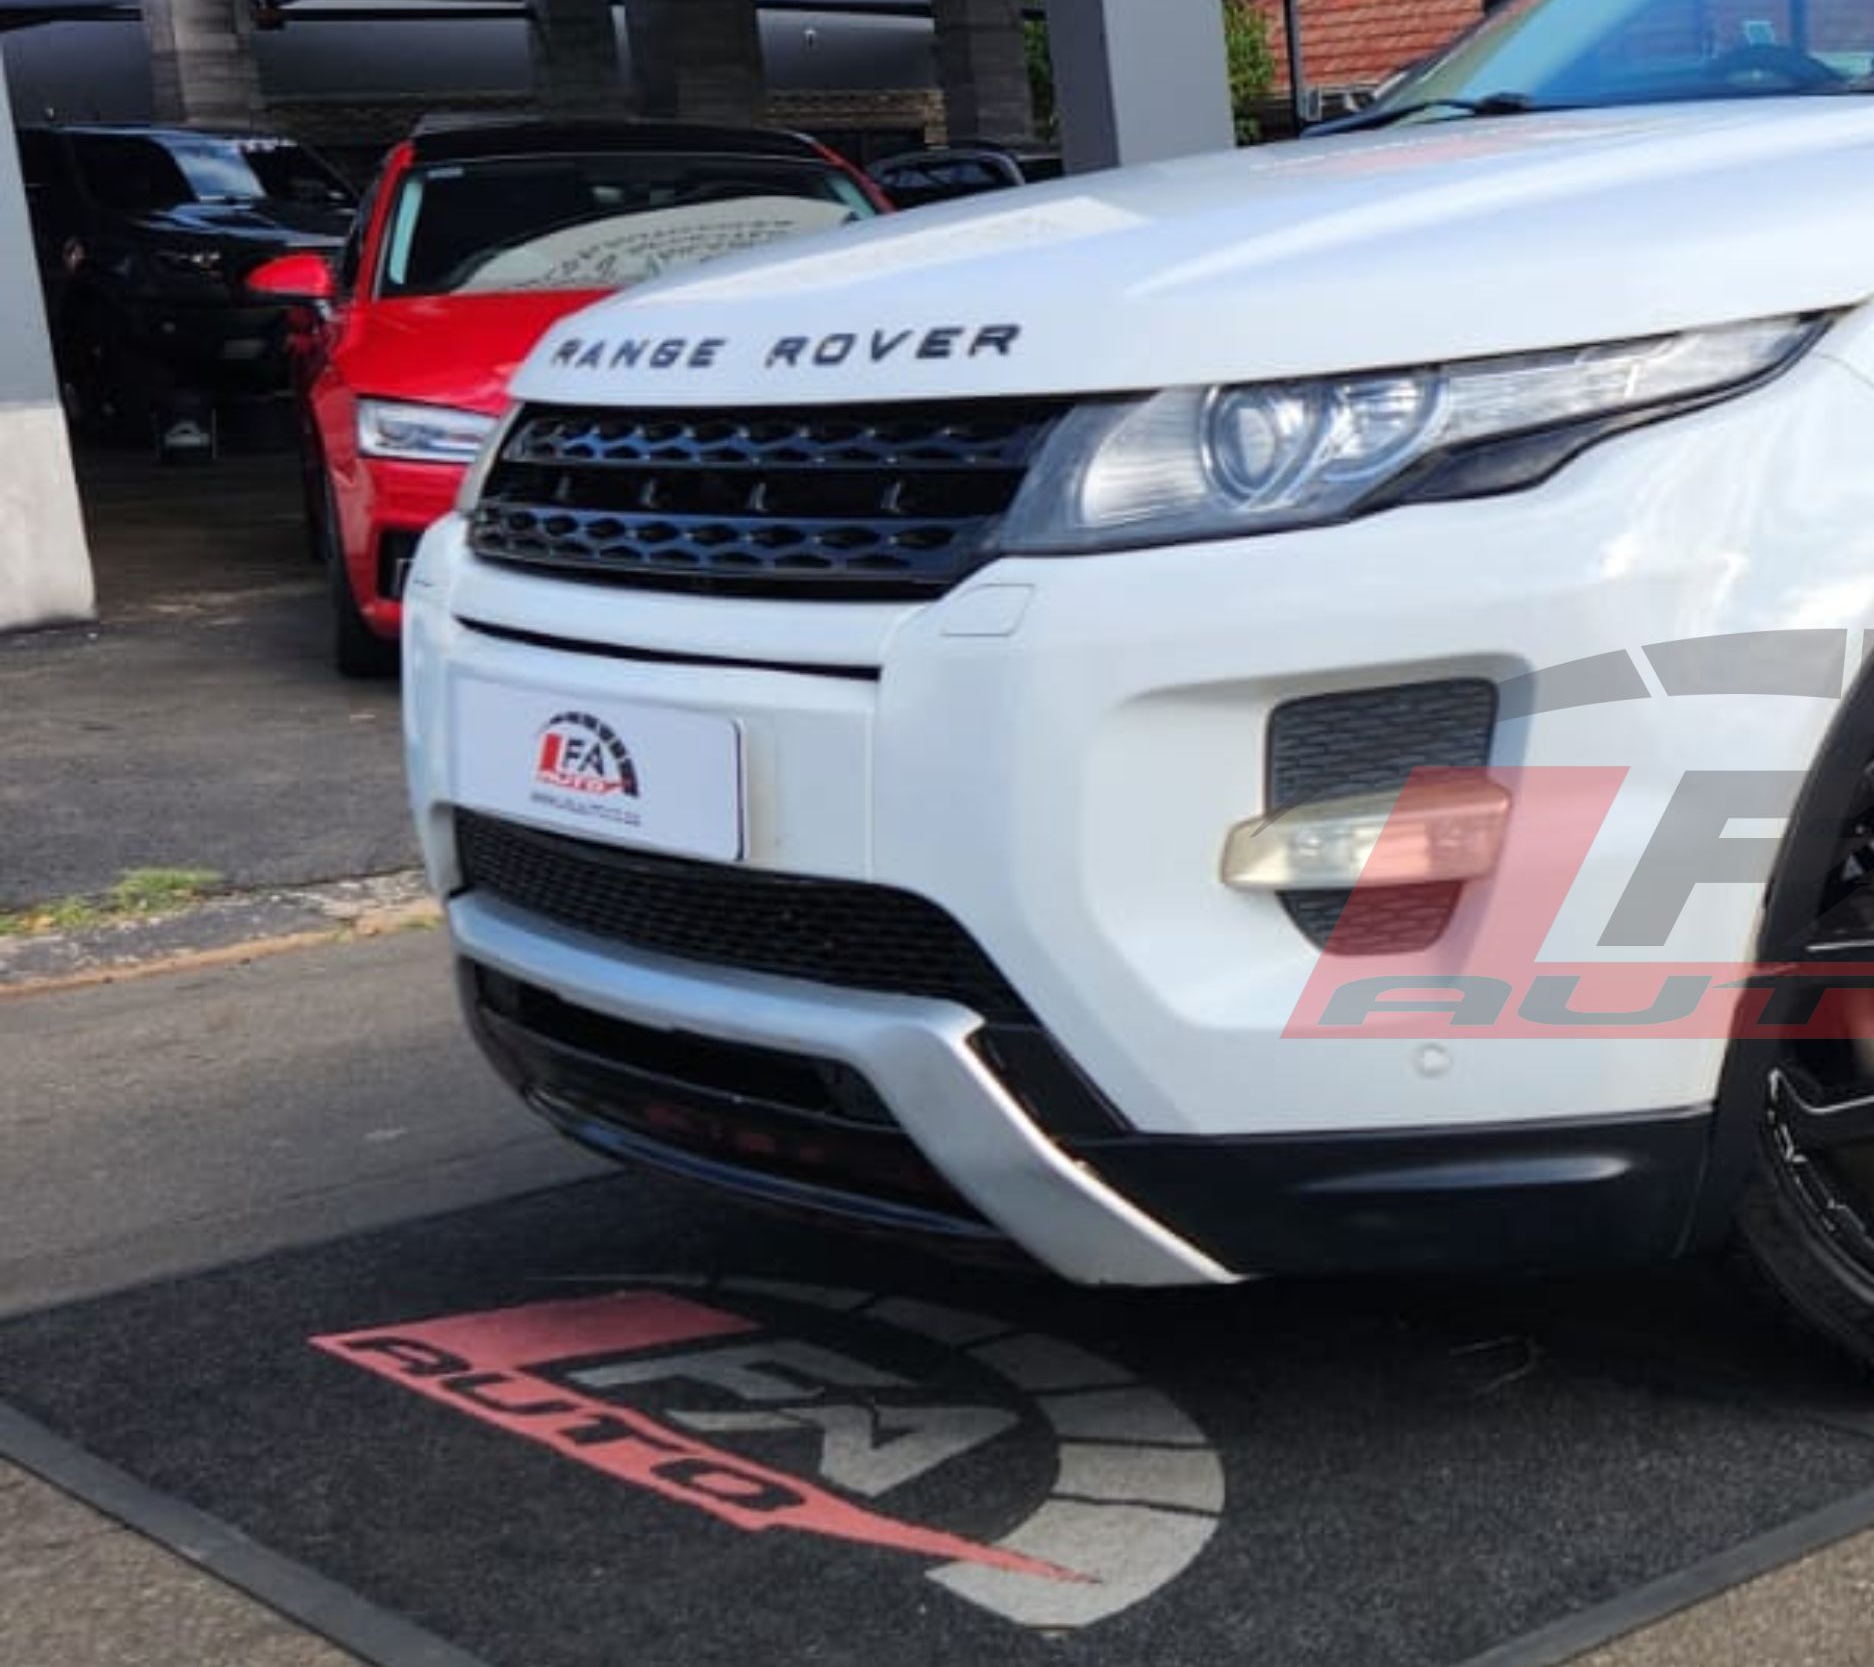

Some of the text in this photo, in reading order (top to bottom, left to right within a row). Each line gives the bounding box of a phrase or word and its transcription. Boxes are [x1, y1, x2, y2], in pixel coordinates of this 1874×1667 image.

[550, 323, 1023, 369] RANGE ROVER
[342, 1336, 808, 1509] AUTO
